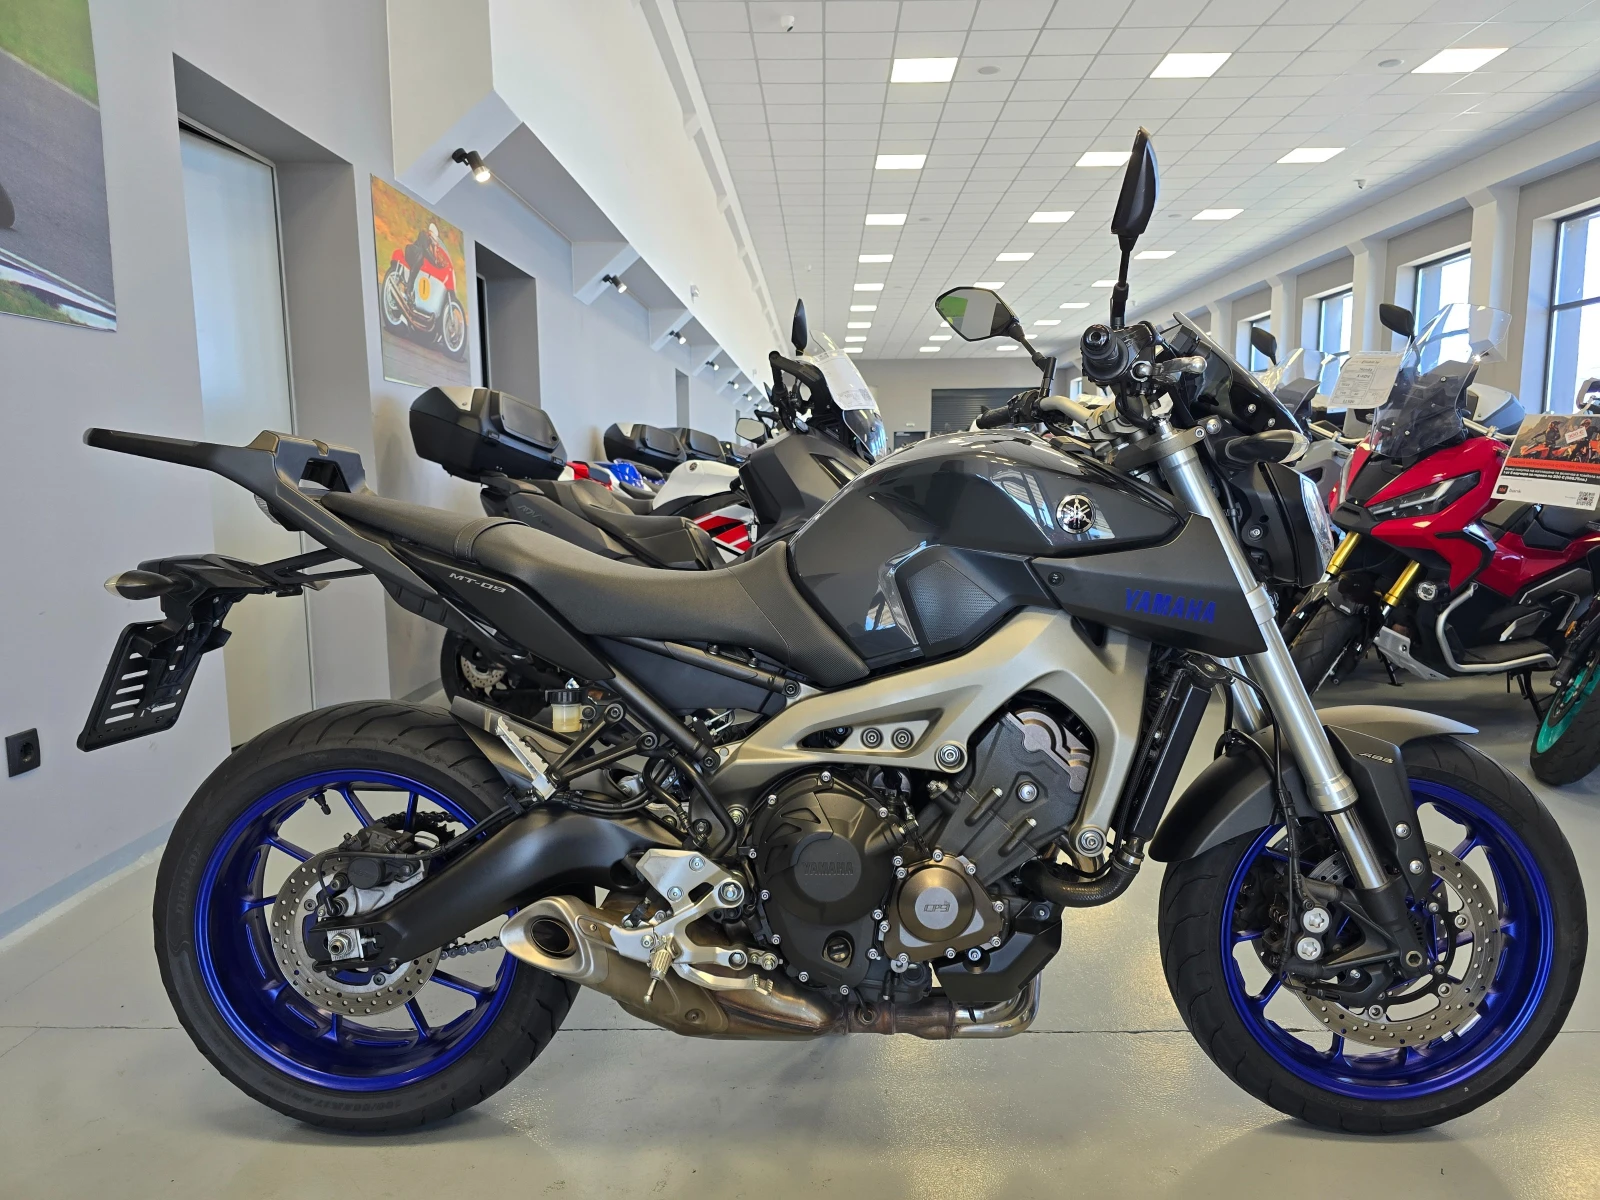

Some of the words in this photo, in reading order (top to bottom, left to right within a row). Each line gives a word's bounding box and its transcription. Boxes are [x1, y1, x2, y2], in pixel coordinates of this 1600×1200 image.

[449, 572, 506, 593] MT-09
[1124, 587, 1216, 624] YAMAHA
[1357, 752, 1394, 764] ABS
[802, 861, 854, 876] YAMAHA
